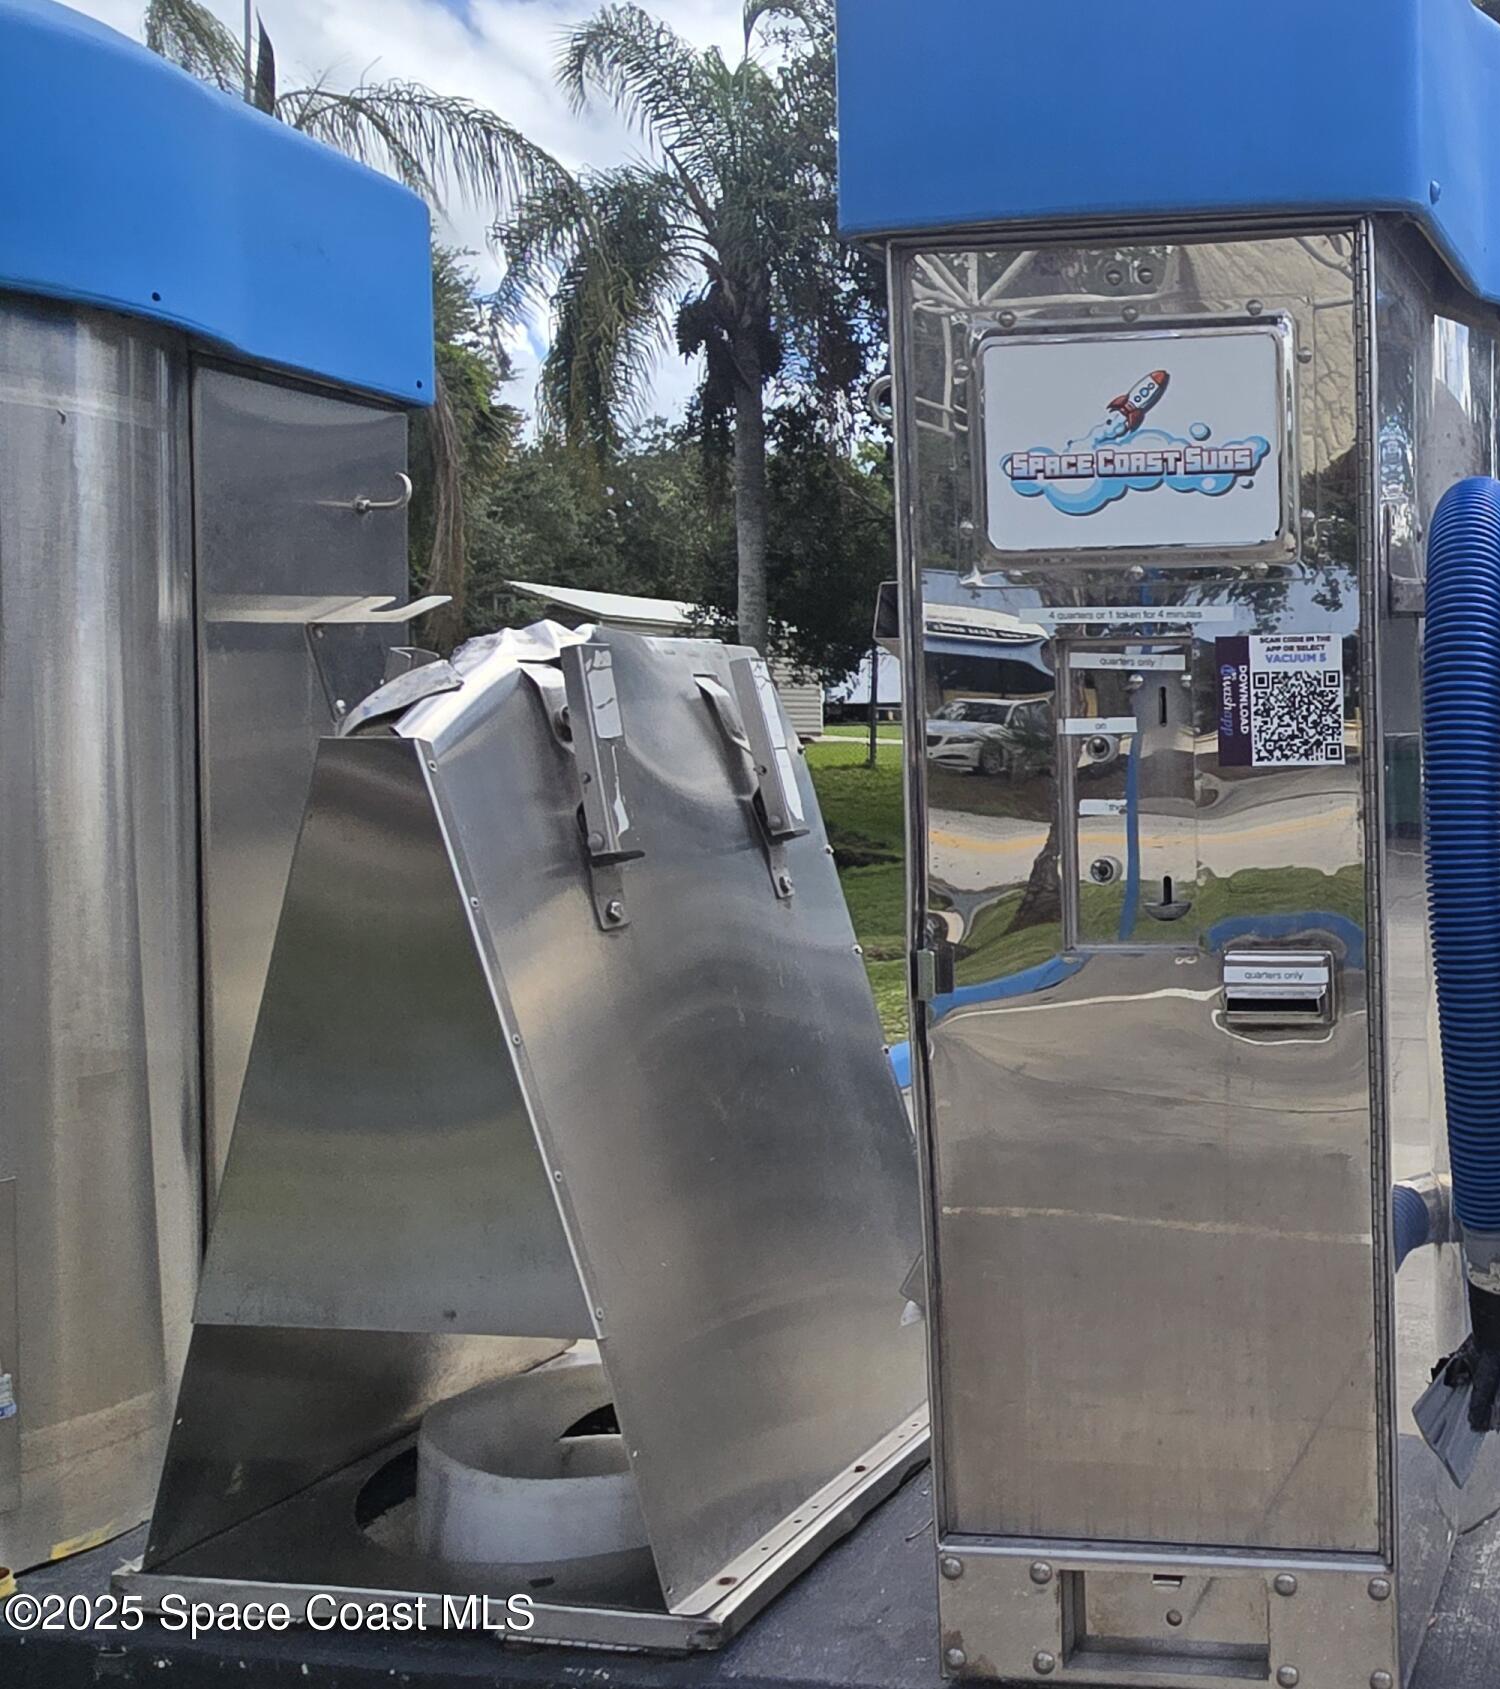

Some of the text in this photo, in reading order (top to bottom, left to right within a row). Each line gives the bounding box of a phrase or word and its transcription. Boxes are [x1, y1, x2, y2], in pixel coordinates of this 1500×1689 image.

[1011, 445, 1256, 480] SPACE COAST SUDS
[1048, 610, 1055, 619] 4
[1057, 611, 1093, 620] quarters
[1096, 611, 1106, 620] or
[1116, 609, 1141, 619] token
[1143, 609, 1156, 619] for
[1158, 609, 1164, 618] 4
[1166, 609, 1202, 619] minutes
[1259, 636, 1281, 644] SCAN
[1283, 644, 1294, 652] OR
[1137, 657, 1156, 668] only
[1265, 652, 1327, 663] VACUUM 5
[1239, 664, 1249, 735] DOWNLOAD
[1284, 970, 1304, 981] only
